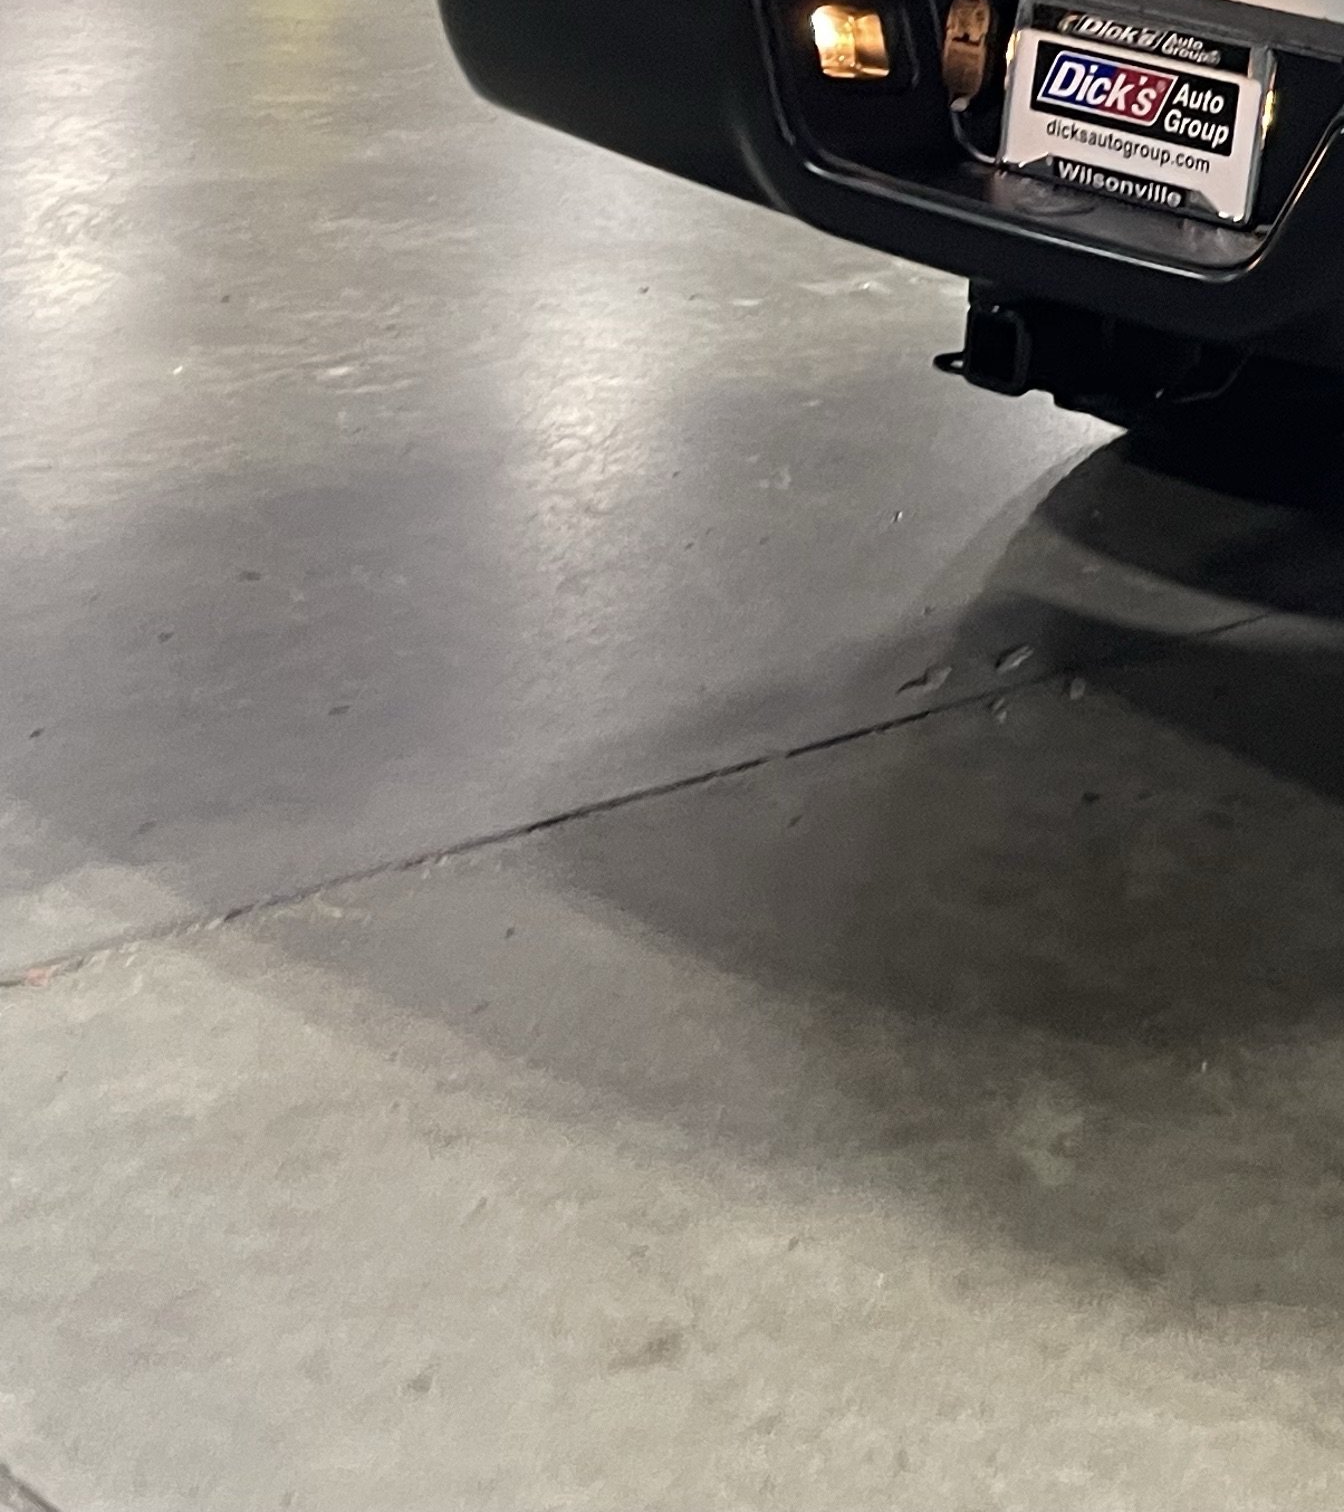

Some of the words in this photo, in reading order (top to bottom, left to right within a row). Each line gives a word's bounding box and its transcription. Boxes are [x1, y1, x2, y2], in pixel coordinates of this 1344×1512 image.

[1165, 32, 1204, 51] Auto
[1048, 58, 1157, 117] Dick's
[1172, 83, 1225, 114] Auto
[1045, 118, 1211, 174] dicksautogroup.com
[1164, 108, 1230, 149] Group
[1056, 159, 1182, 208] Wilsonville
